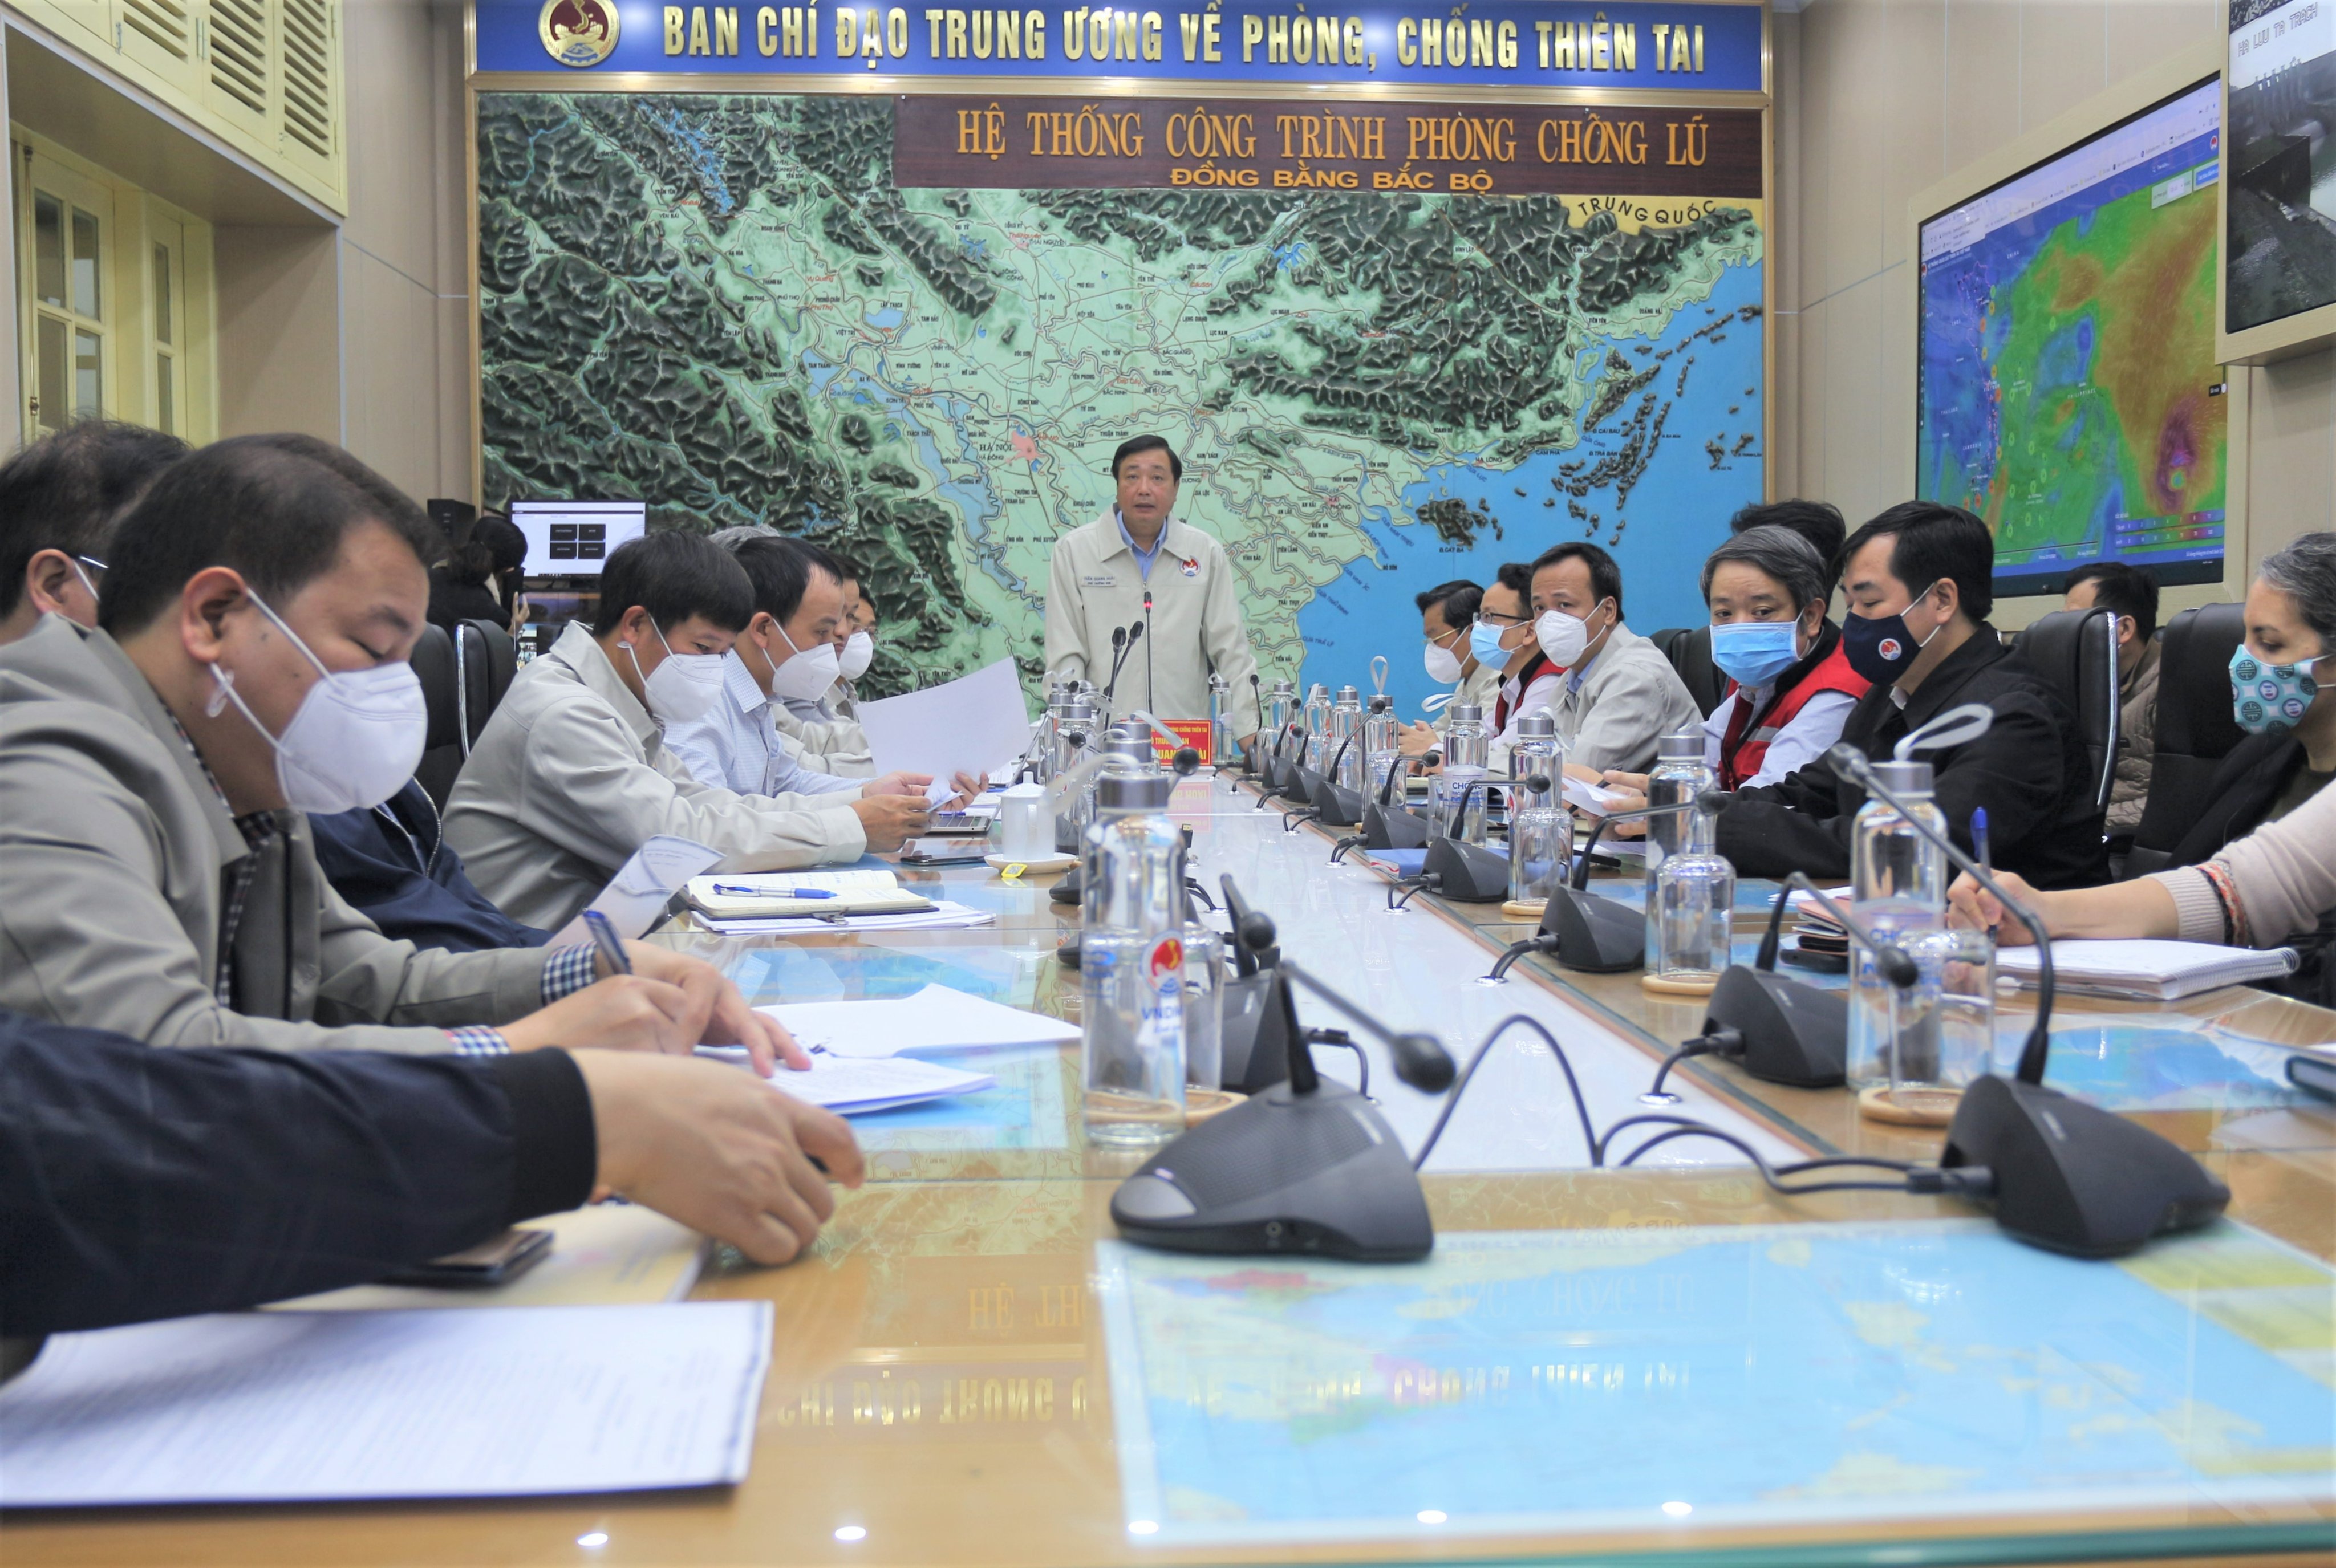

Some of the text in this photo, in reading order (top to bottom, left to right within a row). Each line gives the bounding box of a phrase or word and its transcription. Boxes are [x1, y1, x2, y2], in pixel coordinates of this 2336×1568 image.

[663, 6, 738, 56] BAN
[836, 7, 908, 69] ĐẠO
[925, 9, 1045, 59] TRUNG
[1063, 6, 1162, 61] ƯƠNG
[1179, 0, 1222, 62] VỀ
[1243, 3, 1377, 71] PHÒNG,
[1397, 2, 1518, 68] CHỐNG
[1535, 11, 1636, 70] THIÊN
[1652, 24, 1704, 71] TAI
[957, 102, 1005, 160] HỆ
[1026, 103, 1144, 157] THỐNG
[1166, 106, 1256, 158] CÔNG
[1276, 108, 1386, 160] TRÌNH
[1406, 111, 1517, 162] PHÒNG
[1666, 113, 1709, 166] LŨ
[1170, 159, 1493, 195] ĐỒNG BẰNG BẮC BỘ
[1578, 196, 1717, 224] TRUNG QUỐC
